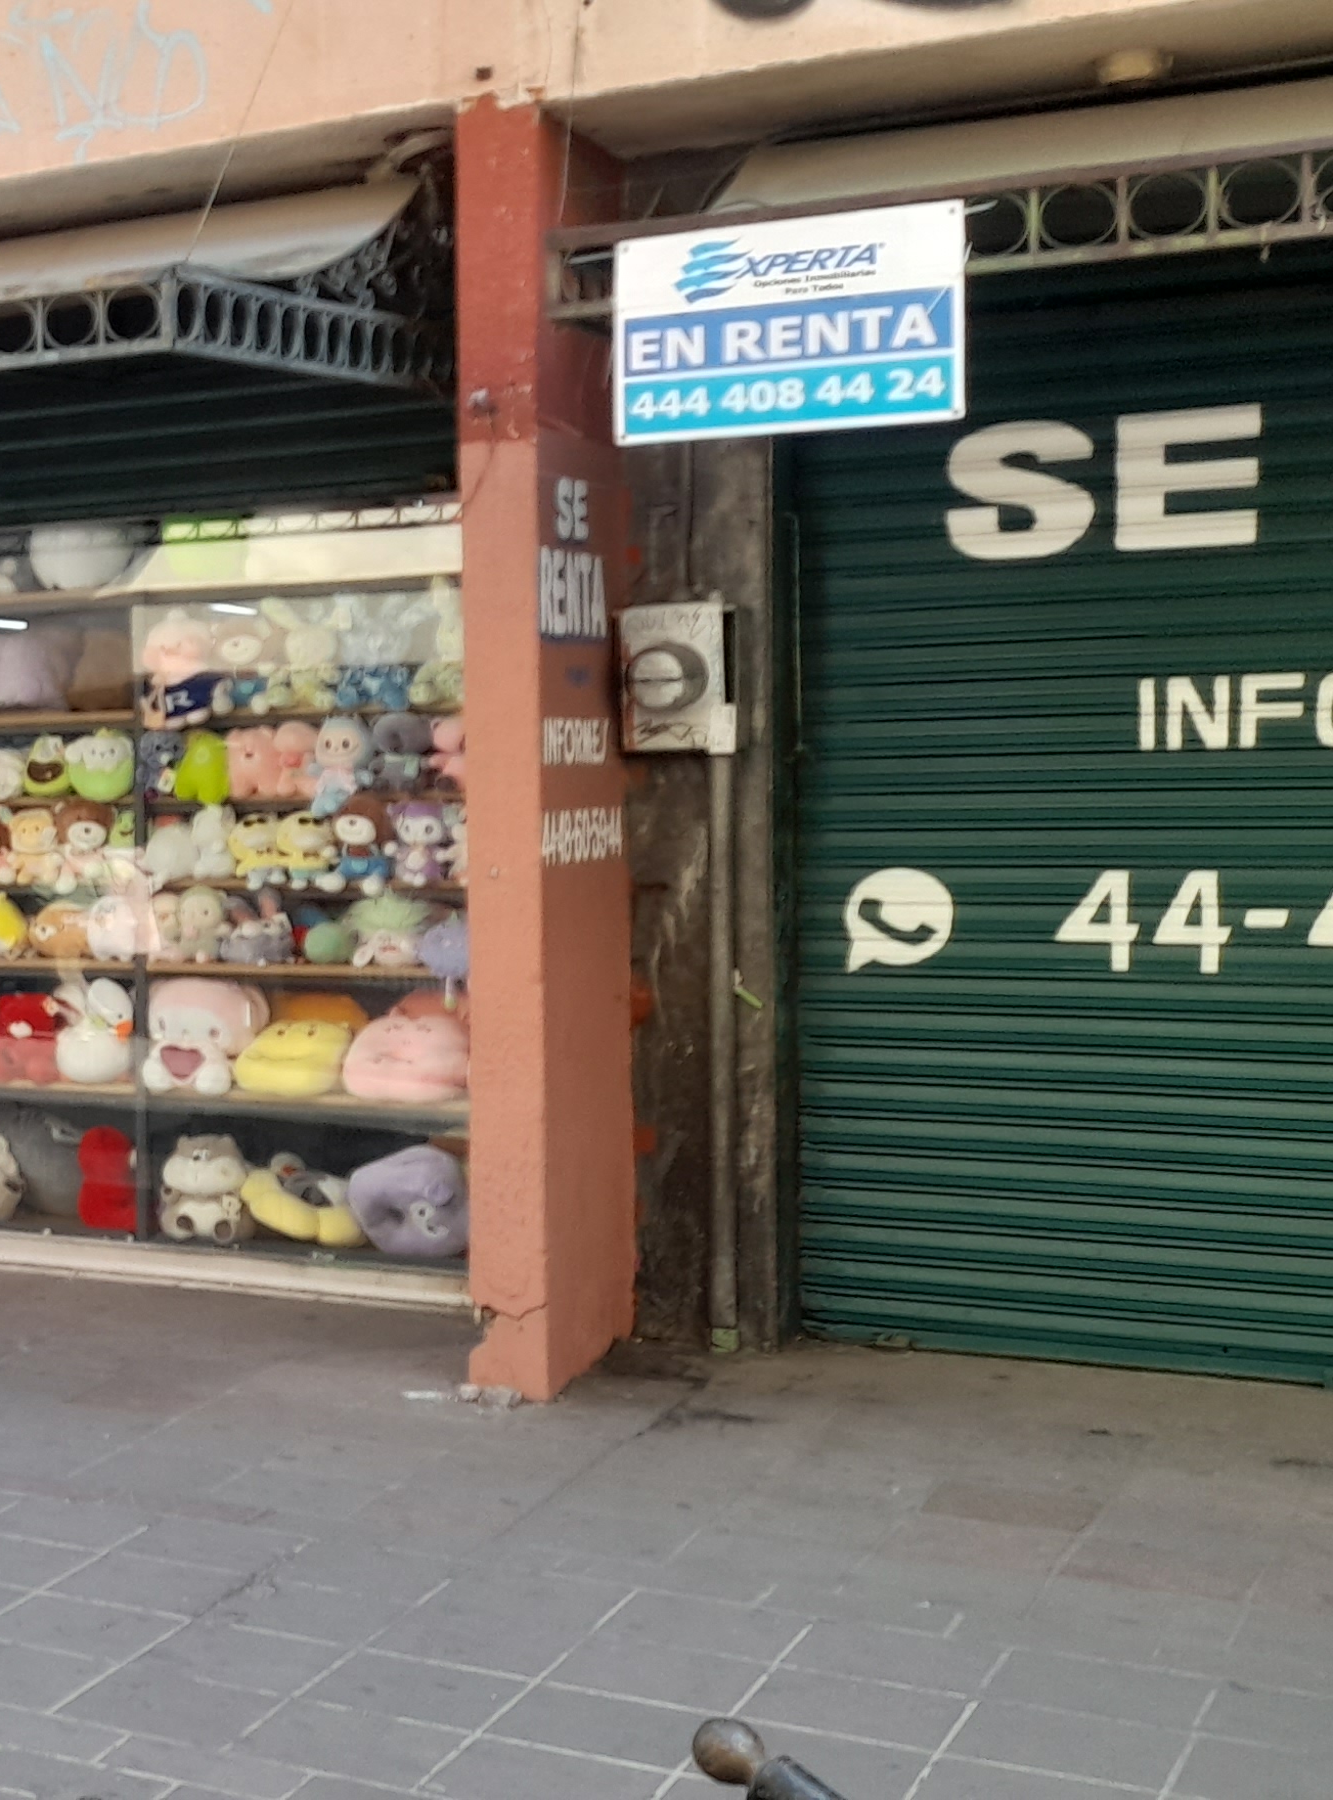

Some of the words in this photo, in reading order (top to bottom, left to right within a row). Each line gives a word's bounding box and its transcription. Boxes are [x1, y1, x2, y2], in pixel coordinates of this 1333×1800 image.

[674, 238, 881, 303] EXPERTA
[628, 324, 706, 371] EN
[721, 302, 938, 365] RENTA
[631, 385, 711, 421] 444
[720, 378, 806, 414] 408
[816, 371, 875, 406] 44
[887, 366, 947, 402] 24
[556, 475, 590, 542] SE
[944, 402, 1263, 562] SE
[540, 544, 608, 640] RENTA
[1138, 672, 1333, 752] INF
